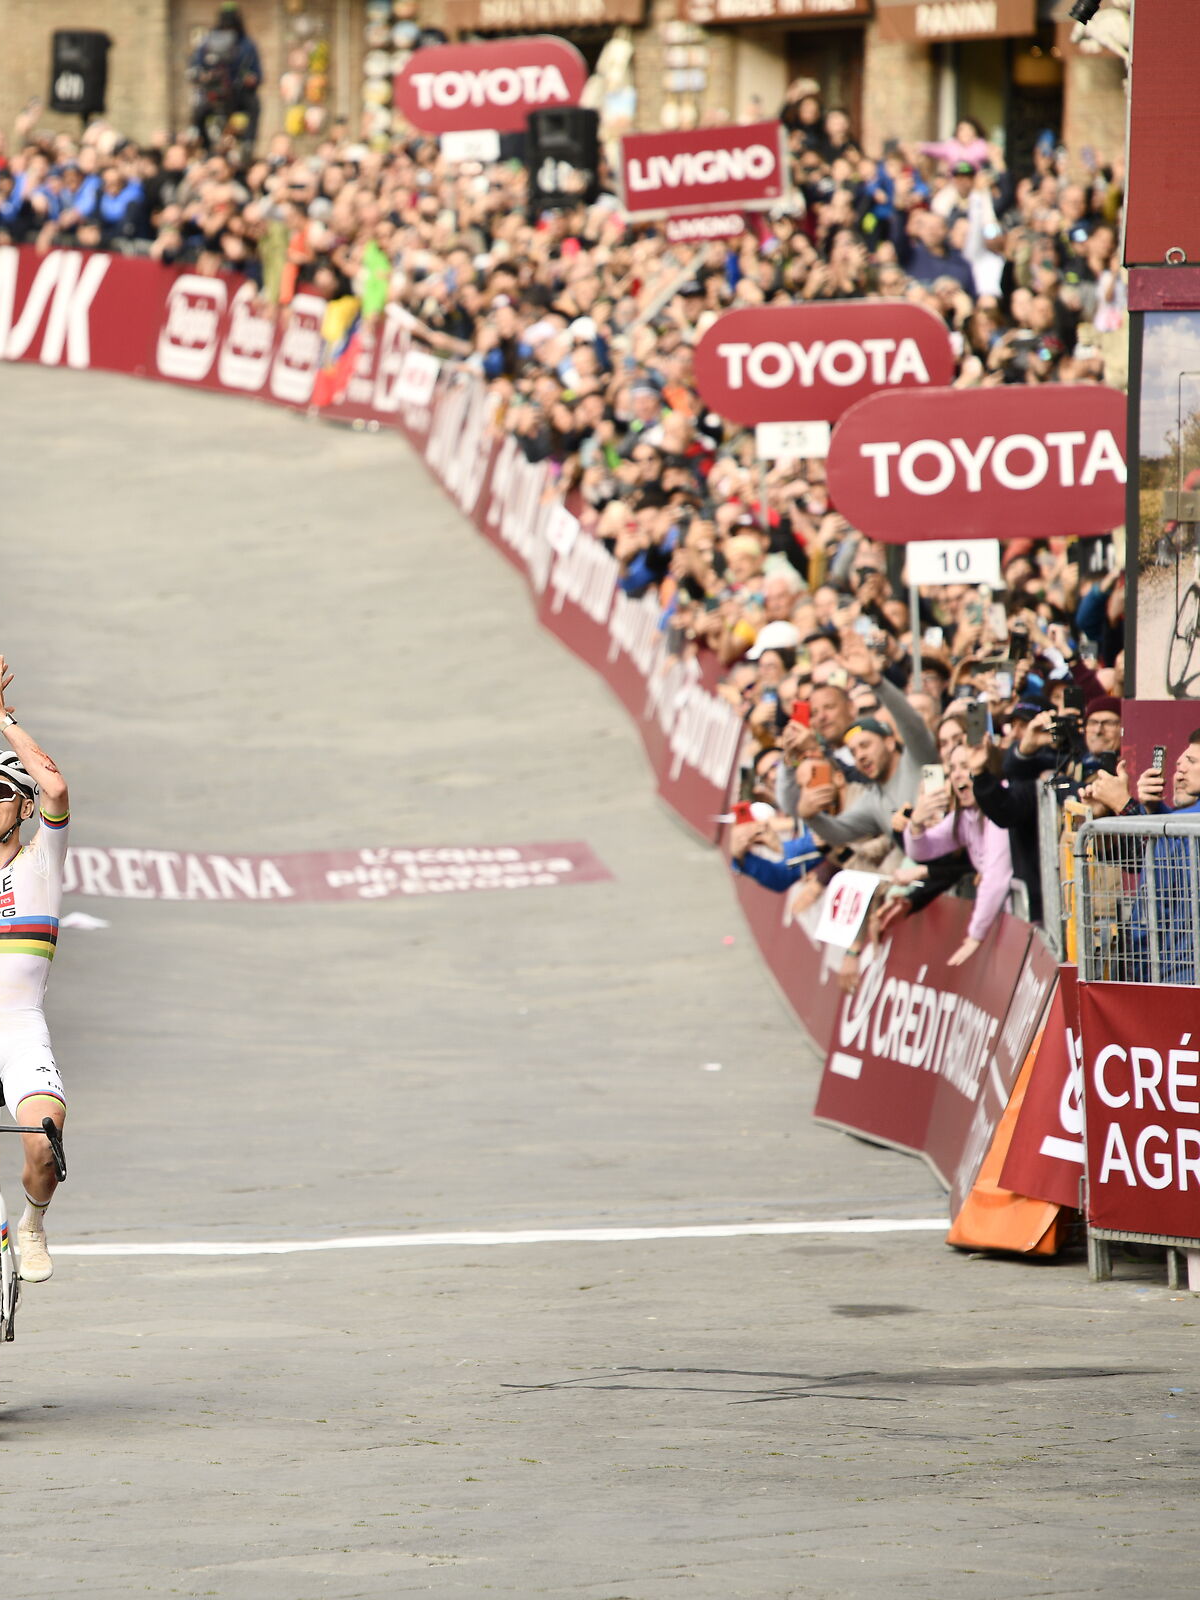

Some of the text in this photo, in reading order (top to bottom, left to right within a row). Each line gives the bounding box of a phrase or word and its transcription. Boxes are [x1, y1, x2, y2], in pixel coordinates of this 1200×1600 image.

[410, 65, 571, 109] TOYOTA
[627, 144, 776, 192] LIVIGNO
[716, 338, 931, 389] TOYOTA
[859, 429, 1128, 498] TOYOTA
[937, 550, 971, 572] 10
[871, 964, 958, 1074] CRÉDIT
